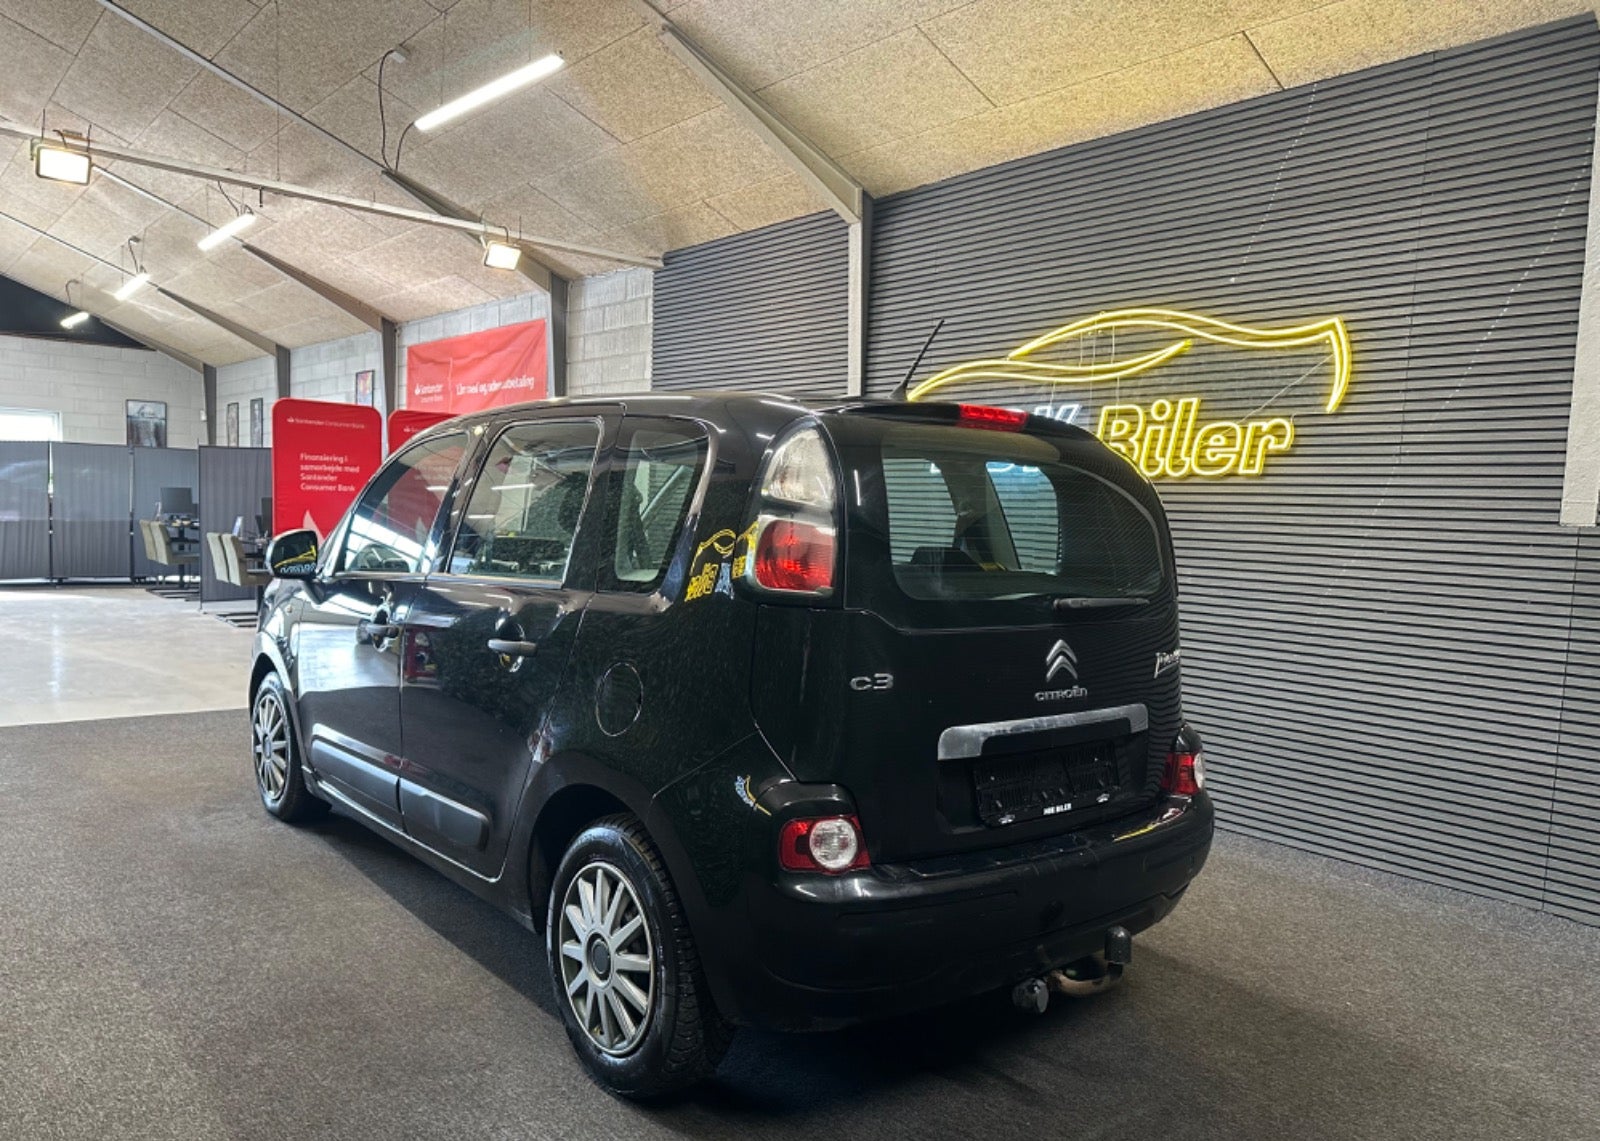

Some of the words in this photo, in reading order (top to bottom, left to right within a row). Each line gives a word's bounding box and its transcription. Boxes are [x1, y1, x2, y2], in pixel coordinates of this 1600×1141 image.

[1098, 398, 1294, 477] Biler
[300, 453, 343, 464] Finansiering
[300, 464, 342, 474] samarbejde
[343, 465, 360, 473] med
[300, 472, 338, 482] Santander
[300, 482, 337, 492] Consumer
[337, 483, 356, 492] Bank
